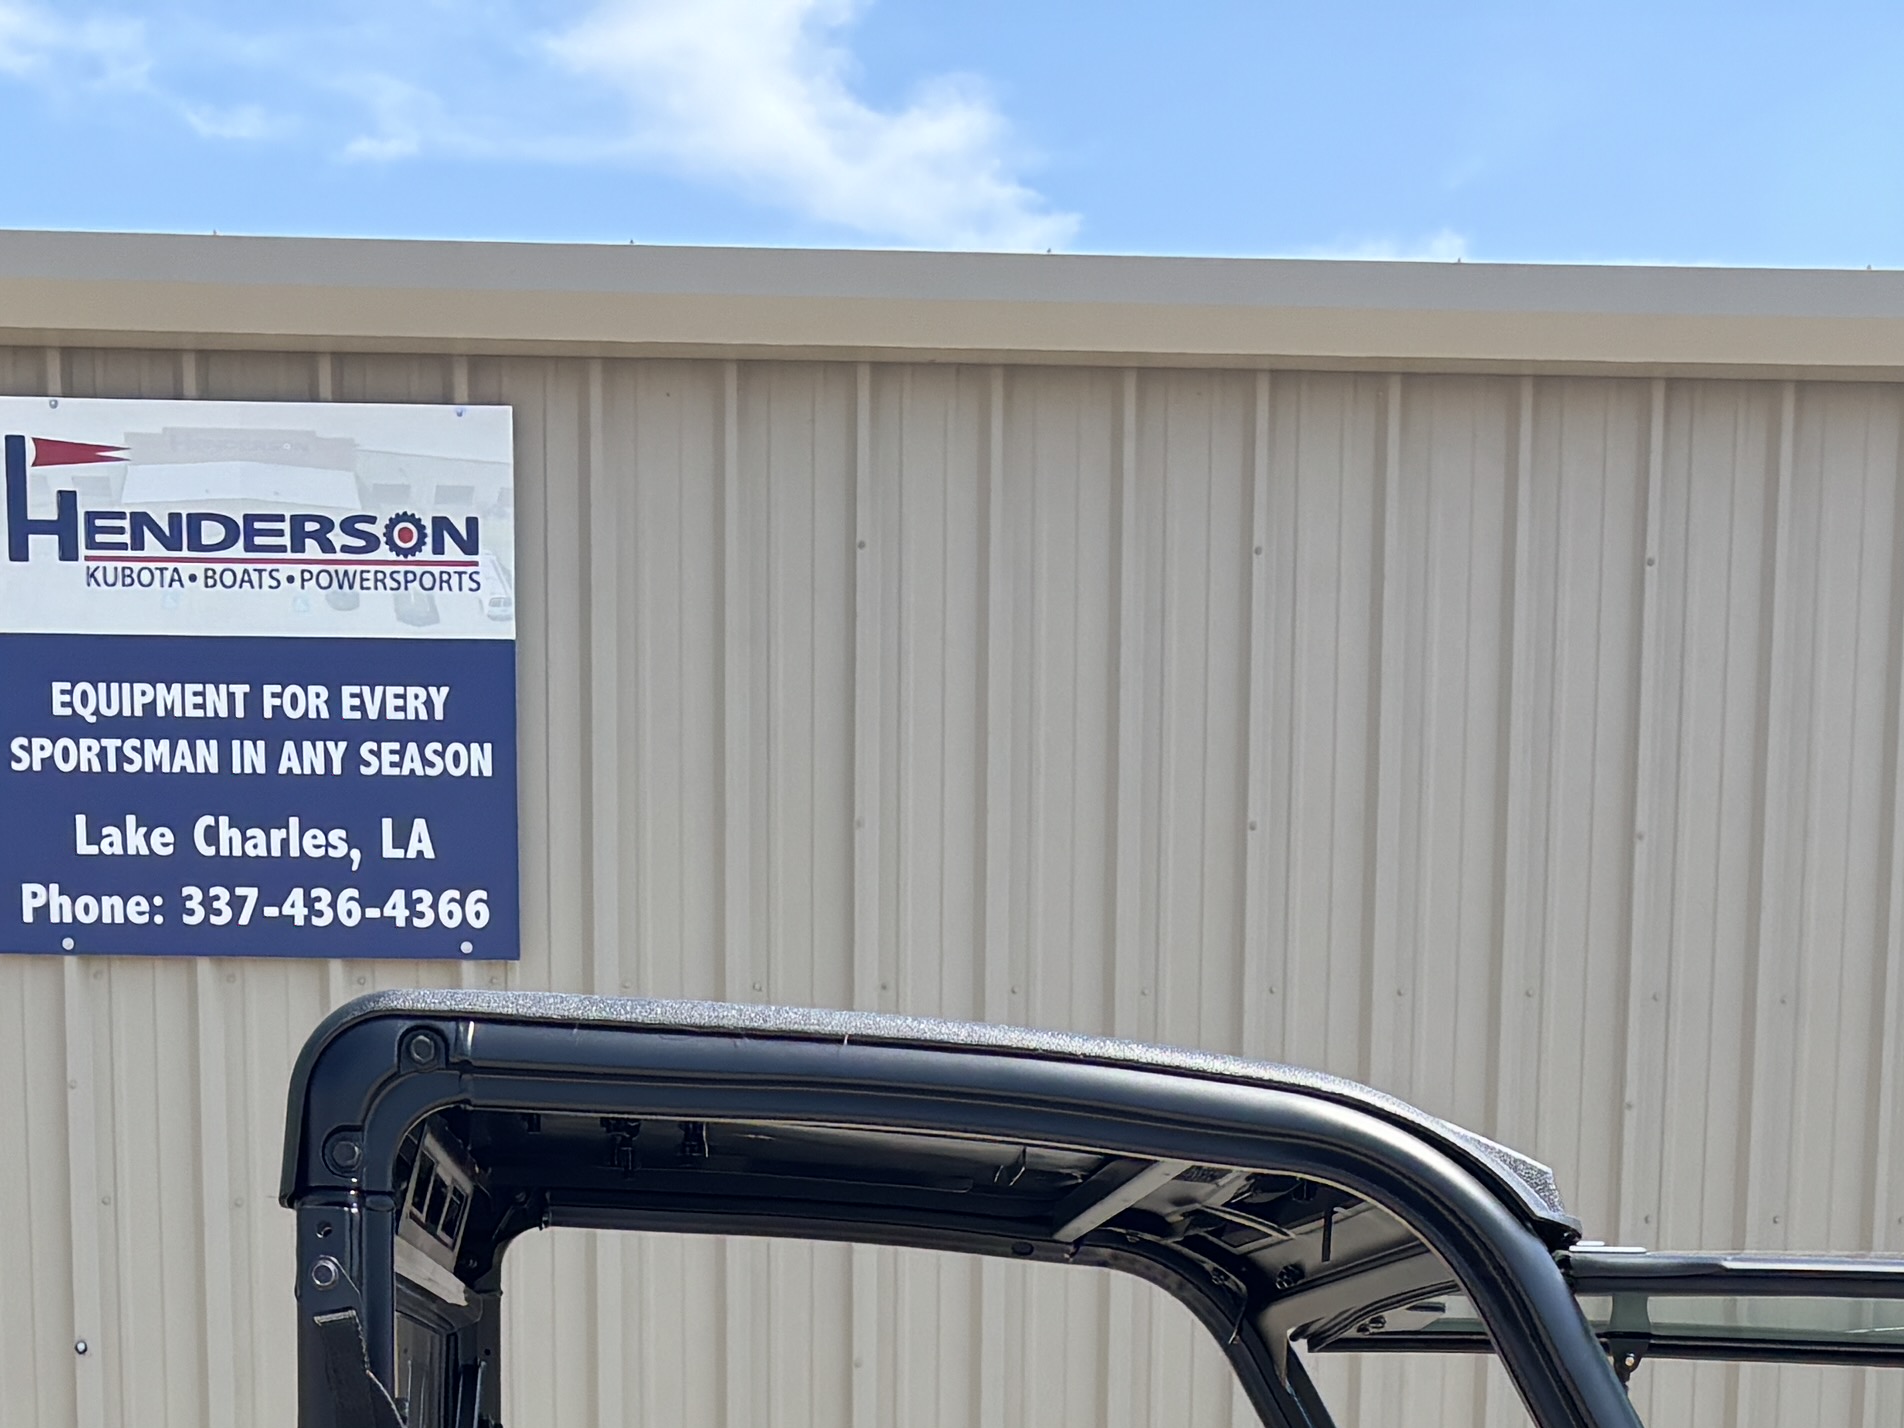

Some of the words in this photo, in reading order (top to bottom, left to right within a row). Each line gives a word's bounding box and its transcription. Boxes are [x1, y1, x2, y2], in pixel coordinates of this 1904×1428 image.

[5, 435, 478, 562] HENDERSON
[87, 566, 184, 587] KUBOTA
[205, 568, 280, 589] BOATS
[301, 570, 480, 591] POWERSPORTS
[52, 682, 250, 723] EQUIPMENT
[263, 685, 329, 719] FOR
[342, 686, 449, 720] EVERY
[11, 737, 218, 773] SPORTSMAN
[232, 740, 265, 774] IN
[279, 741, 347, 774] ANY
[360, 741, 492, 776] SEASON
[76, 814, 174, 855] Lake
[194, 815, 361, 871] Charles,
[382, 818, 435, 858] LA
[22, 883, 163, 924] Phone:
[182, 886, 489, 928] 337-436-4366
